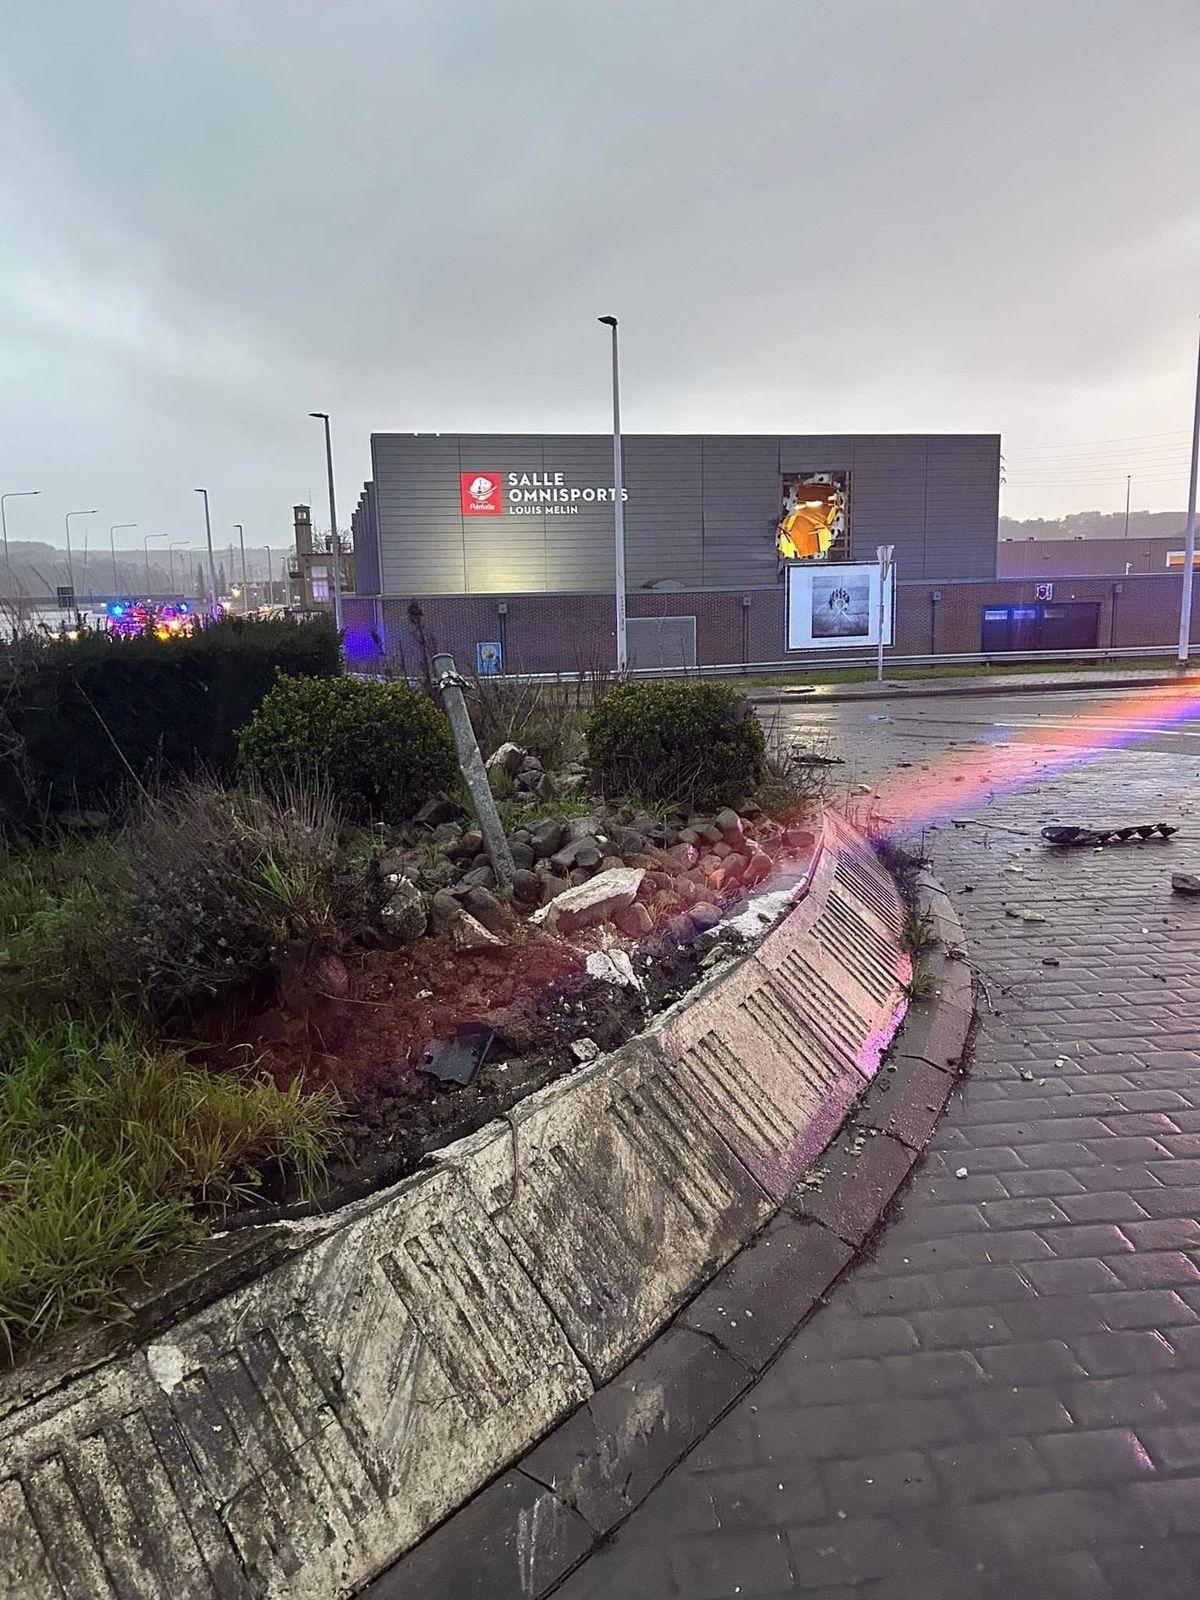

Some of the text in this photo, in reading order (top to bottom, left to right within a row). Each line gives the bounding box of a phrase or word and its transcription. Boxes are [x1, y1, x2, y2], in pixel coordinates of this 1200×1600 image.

[508, 472, 564, 486] SALLE
[508, 488, 629, 502] OMNISPORTS
[509, 505, 578, 515] LOUIS MELIN
